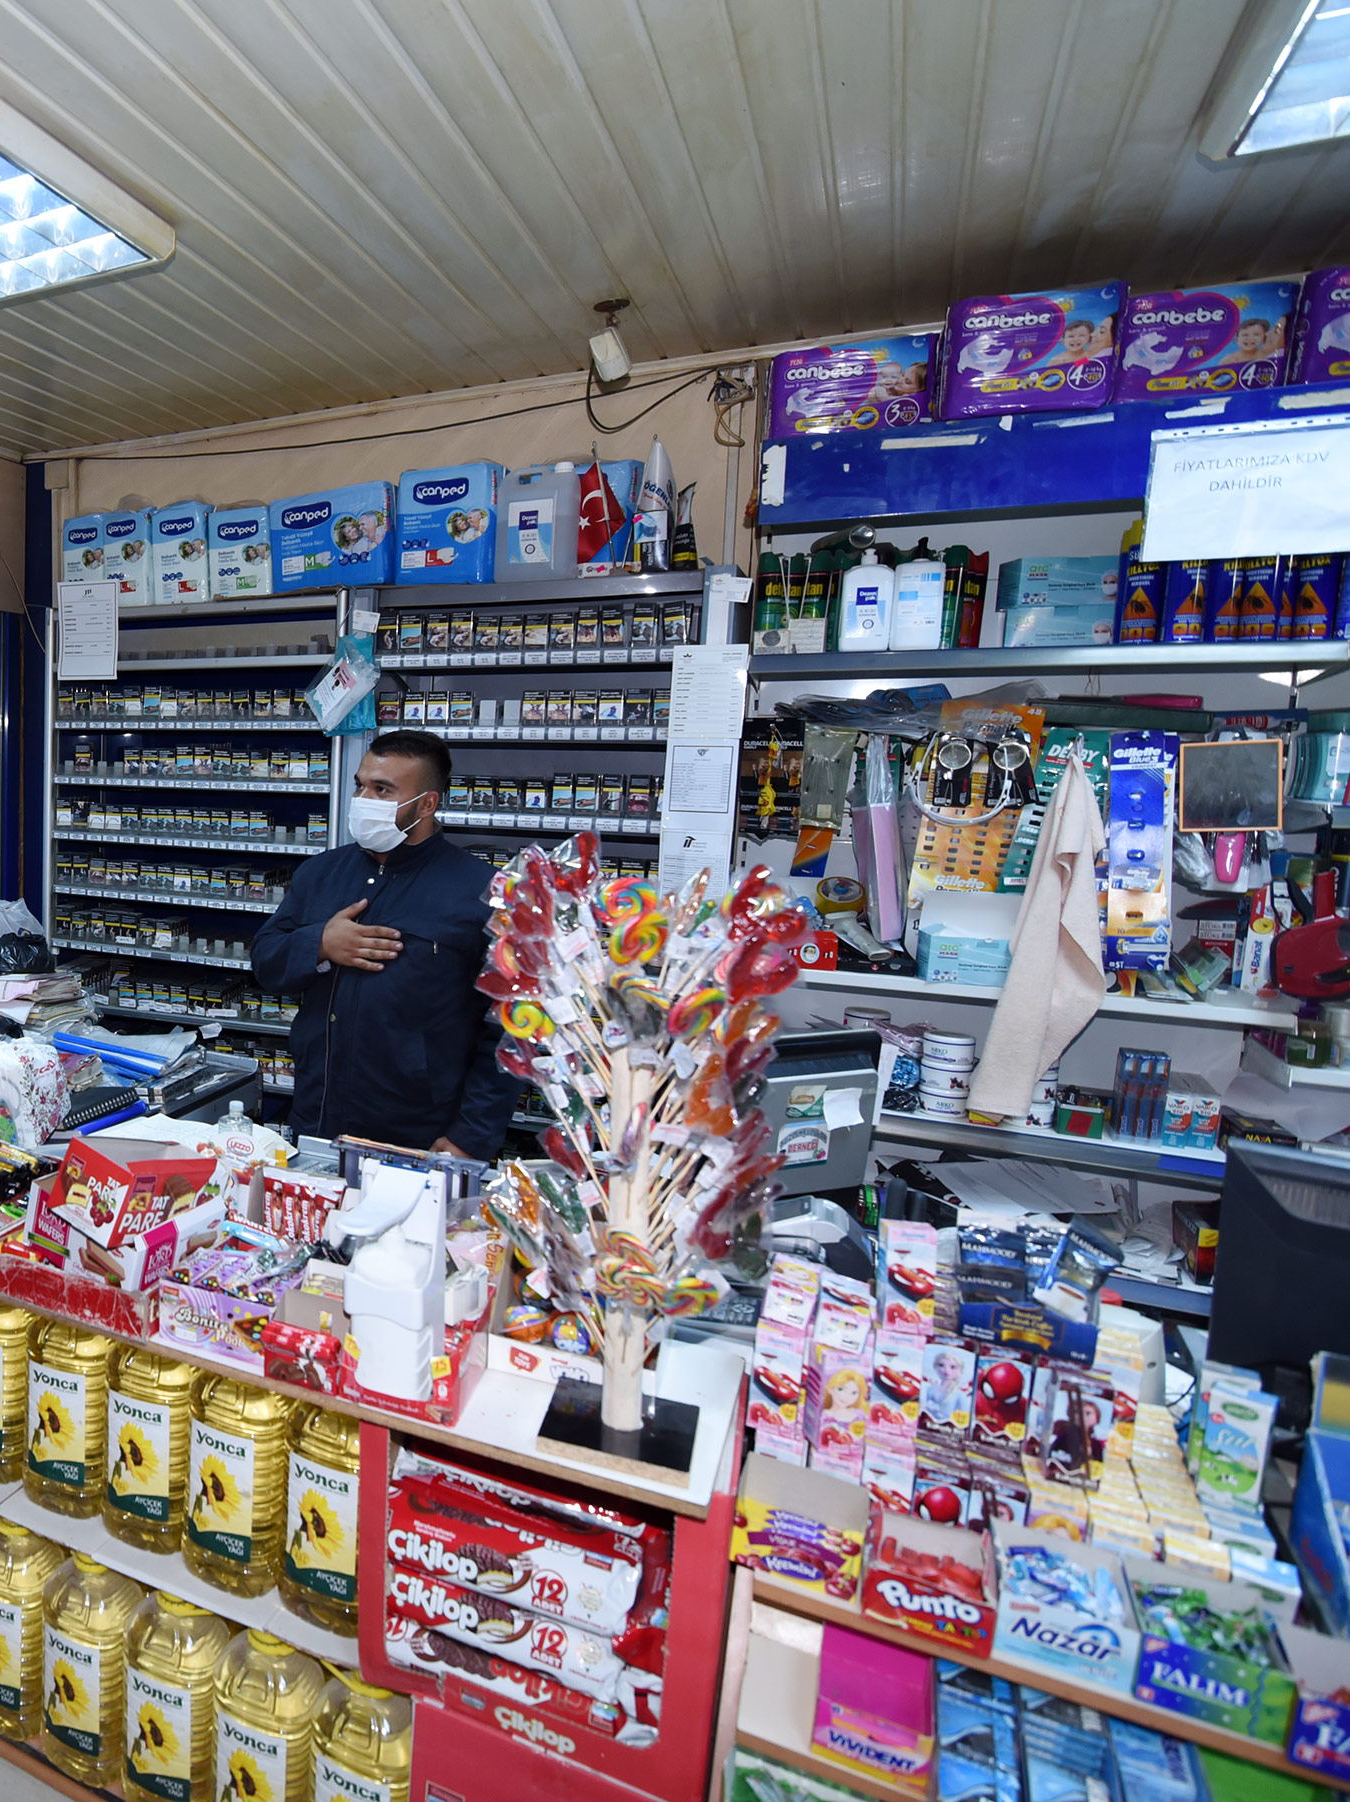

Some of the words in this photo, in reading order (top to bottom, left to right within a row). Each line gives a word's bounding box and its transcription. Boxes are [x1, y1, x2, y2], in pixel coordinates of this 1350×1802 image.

[964, 311, 1051, 330] canbebe
[1132, 307, 1225, 326] canbebe
[785, 363, 865, 382] canbebe
[1070, 365, 1084, 385] 4
[1243, 365, 1256, 385] 4
[889, 403, 901, 421] 3
[1174, 454, 1291, 472] FİYATLARIMIZA
[1296, 451, 1330, 465] KDV
[422, 483, 467, 499] canped
[1209, 475, 1283, 491] DAHİLDİR
[288, 506, 330, 522] canped
[70, 530, 97, 543] canped
[108, 522, 136, 535] canped
[161, 520, 193, 535] canped
[221, 524, 257, 539] canped
[305, 556, 315, 568] M
[427, 553, 434, 563] L
[1029, 565, 1048, 573] arc
[237, 577, 245, 587] M
[962, 709, 1023, 724] Gillette
[1027, 707, 1043, 716] 48
[1113, 746, 1162, 759] Gillette
[934, 874, 985, 890] Gillette
[939, 943, 959, 951] arc
[1251, 941, 1263, 968] Banat
[935, 1101, 954, 1109] ARKO
[230, 1140, 251, 1152] LEZZO
[107, 1176, 122, 1190] TAT
[151, 1195, 170, 1211] TAT
[38, 1217, 65, 1246] WAFERS
[118, 1211, 165, 1235] PARE
[961, 1242, 1017, 1260] MAHMOOD
[33, 1369, 78, 1392] yonca
[113, 1400, 162, 1424] yonca
[196, 1430, 246, 1458] yonca
[294, 1462, 349, 1494] yonca
[215, 1533, 244, 1548] AYÇİÇEK
[387, 1528, 479, 1583] Çikilop
[316, 1570, 347, 1586] AYÇİÇEK
[534, 1574, 565, 1601] 12
[390, 1573, 479, 1631] Çikilop
[533, 1598, 564, 1616] ADET
[876, 1579, 982, 1625] Punto
[534, 1624, 565, 1651] 12
[1010, 1616, 1116, 1662] Nazar
[49, 1634, 92, 1664] yonca
[533, 1650, 563, 1669] ADET
[132, 1675, 183, 1708] yonca
[1152, 1659, 1248, 1708] FALIM
[223, 1720, 278, 1756] yonca
[494, 1705, 576, 1755] Çikilop
[322, 1765, 381, 1802] yonca
